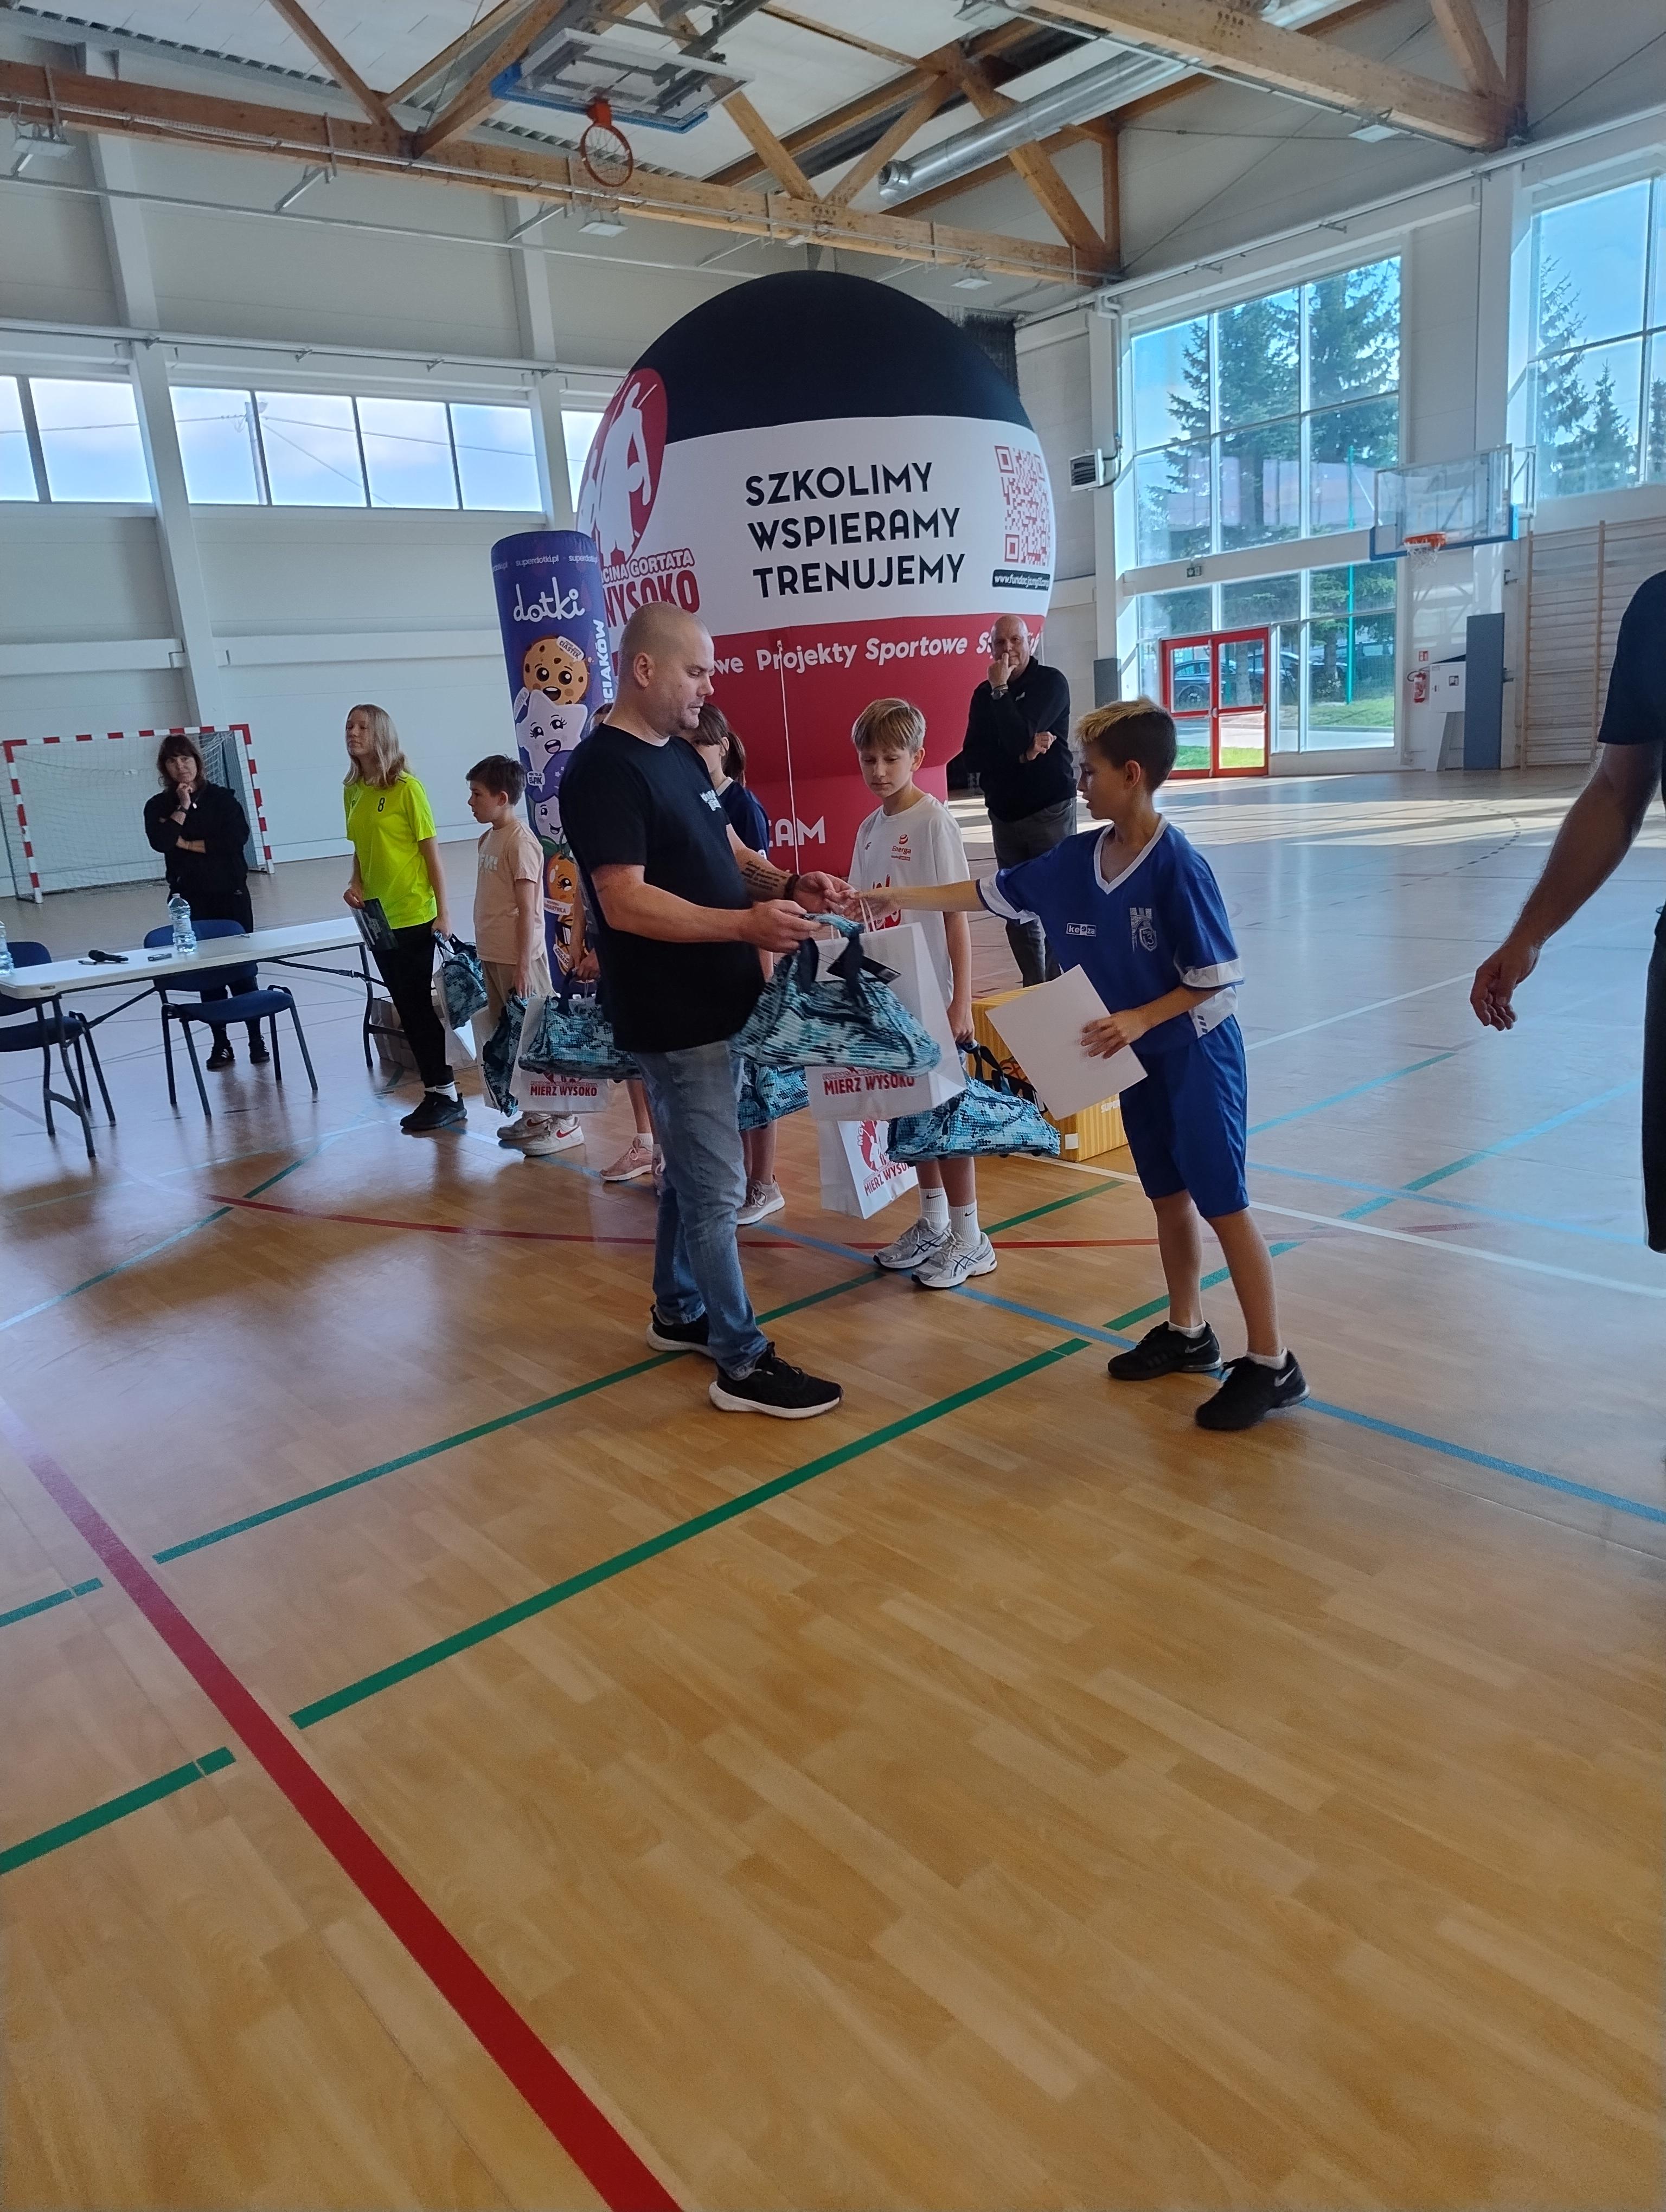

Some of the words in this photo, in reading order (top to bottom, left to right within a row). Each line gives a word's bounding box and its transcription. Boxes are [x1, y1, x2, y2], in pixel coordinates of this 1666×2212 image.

[746, 462, 932, 506] SZKOLIMY
[747, 507, 960, 552] WSPIERAMY
[630, 548, 695, 578] GORTATA
[753, 554, 965, 597] TRENUJEMY
[514, 576, 585, 622] dotki
[593, 619, 614, 703] CIAKÓW
[714, 657, 744, 674] we
[757, 643, 857, 673] Projekty
[865, 636, 968, 666] Sportowe
[377, 798, 386, 812] 8
[768, 815, 825, 847] AM
[892, 846, 912, 855] Energa
[530, 1086, 557, 1096] MIERZ
[559, 1086, 597, 1096] WYSOKO
[824, 1077, 862, 1095] MIERZ
[864, 1073, 915, 1090] WYSOKO
[864, 1173, 884, 1197] MIERZ
[883, 1162, 911, 1181] WYSO
